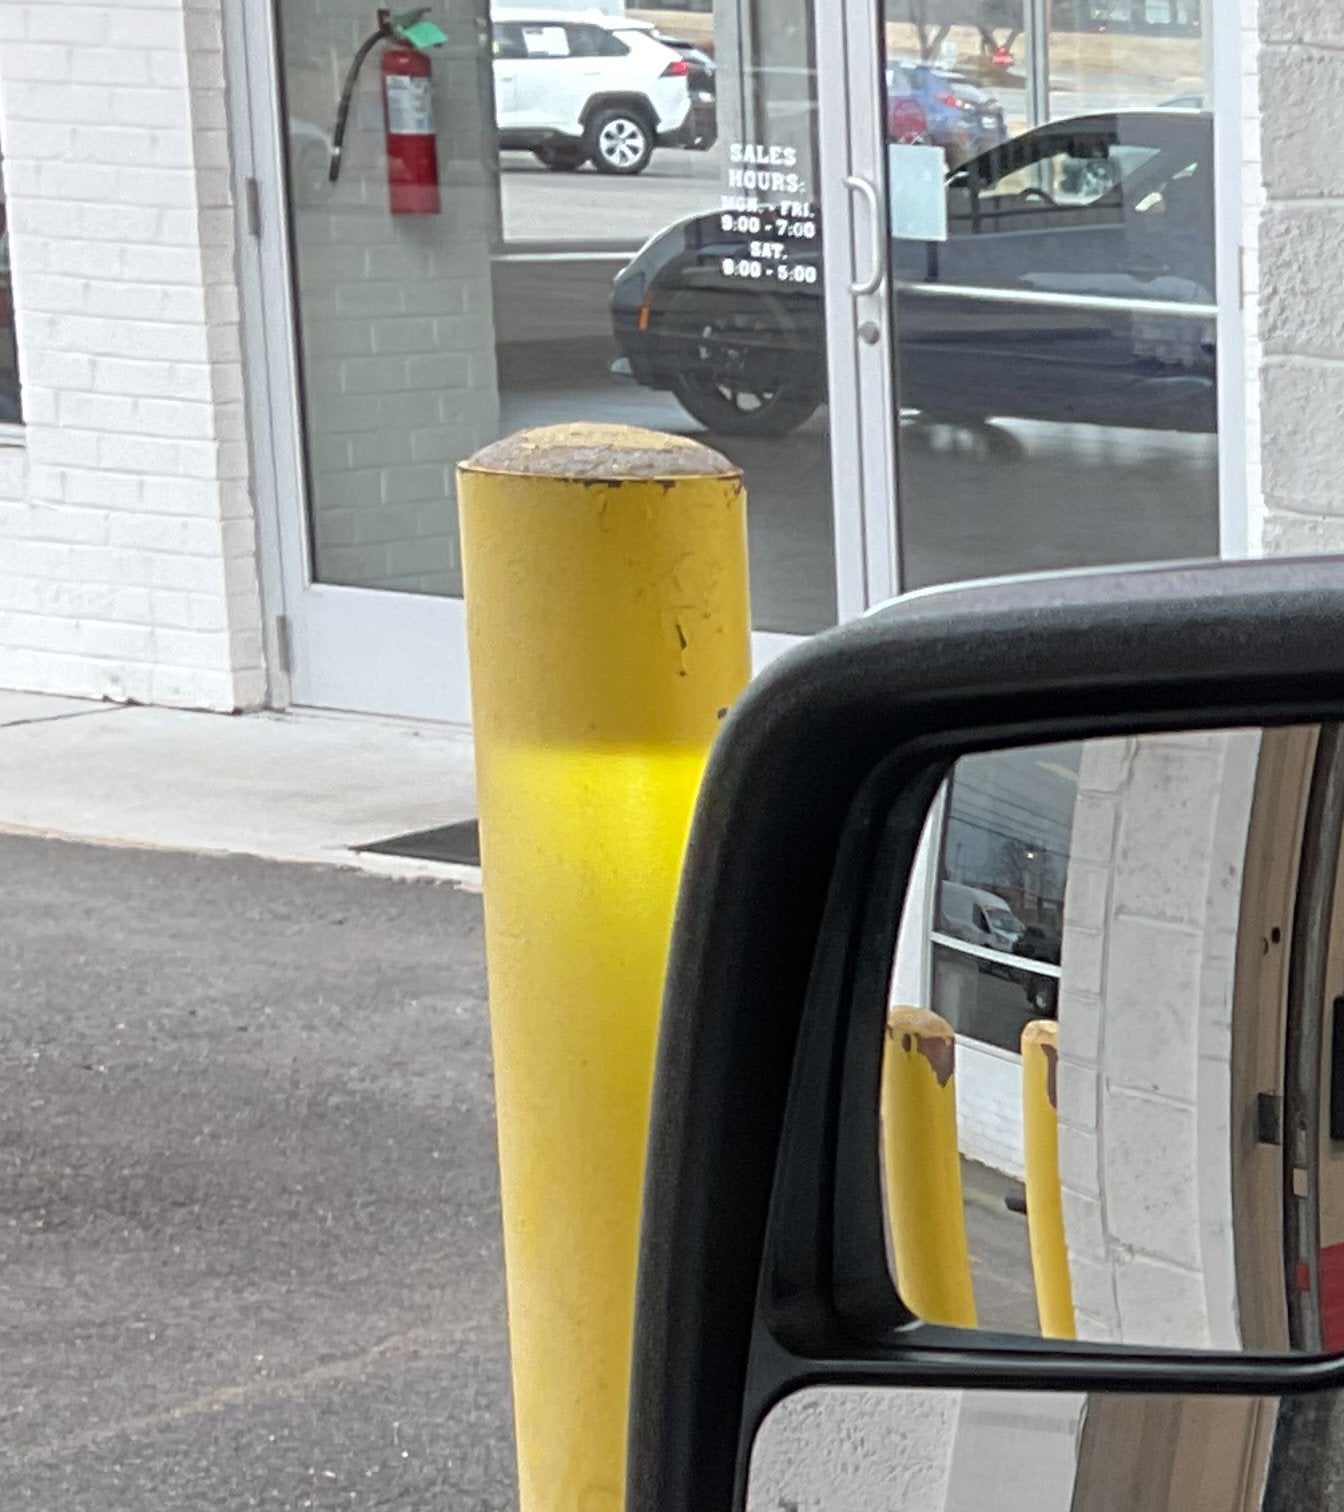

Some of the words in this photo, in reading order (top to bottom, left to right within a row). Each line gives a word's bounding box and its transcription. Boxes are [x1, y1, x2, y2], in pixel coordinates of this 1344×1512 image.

[729, 143, 796, 166] SALES
[728, 169, 806, 193] HOURS:
[779, 200, 816, 218] FRI.
[721, 214, 760, 233] 9:00
[775, 218, 816, 238] 7:00
[750, 241, 788, 260] SAT.
[777, 265, 817, 284] 5:00
